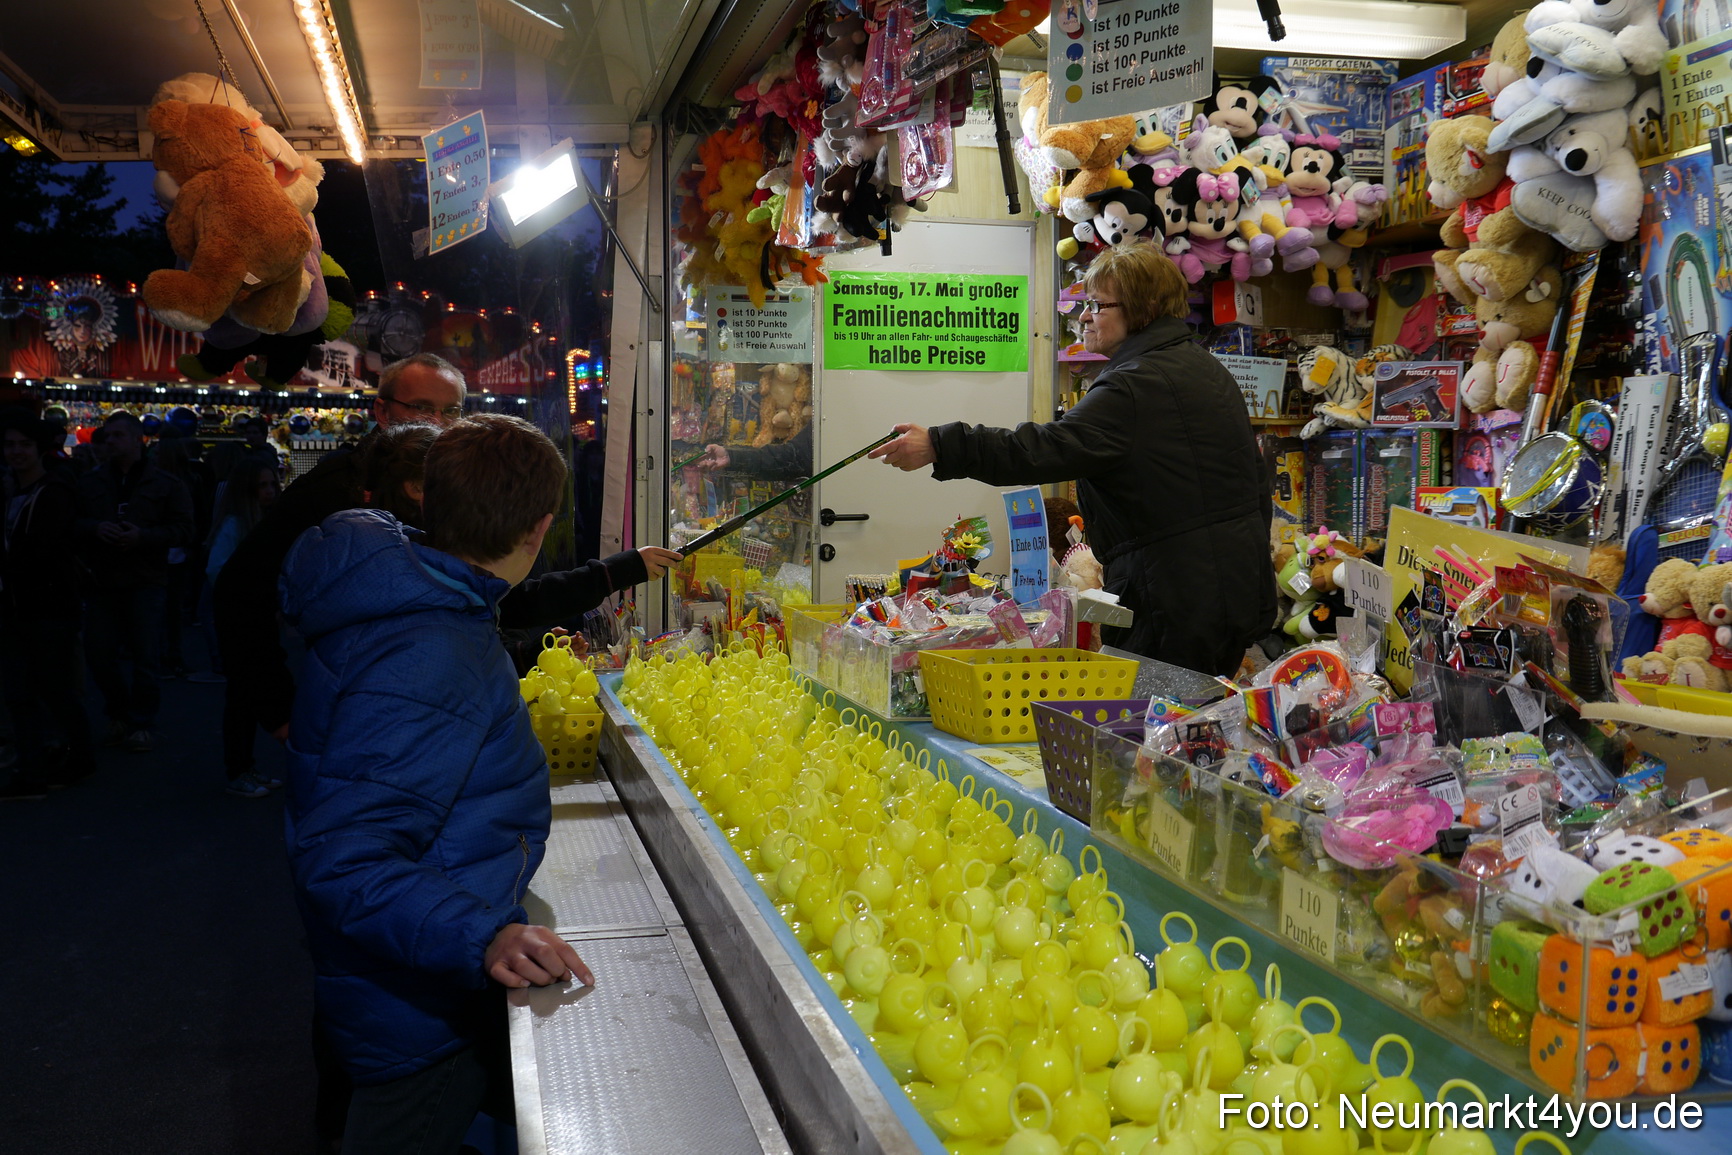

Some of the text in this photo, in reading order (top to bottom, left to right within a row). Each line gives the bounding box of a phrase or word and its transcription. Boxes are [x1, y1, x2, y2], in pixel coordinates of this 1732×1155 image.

[1094, 2, 1180, 32] ist 10 Punkte
[1093, 24, 1179, 53] ist 50 Punkte
[1092, 44, 1186, 74] ist 100 Punkte
[1292, 58, 1373, 68] AIRPORT CATENA
[1092, 57, 1204, 95] ist Freie Auswahl
[1672, 69, 1713, 90] 1 Ente
[1673, 84, 1724, 106] 7 Enten
[464, 148, 486, 166] 0,50
[433, 189, 442, 205] 7
[443, 183, 467, 200] Enten
[1538, 187, 1564, 206] KEEP
[432, 213, 446, 231] 12
[447, 208, 470, 223] Enten
[833, 280, 1019, 300] Samstag, 17. Mai großer
[732, 309, 787, 317] ist 10 Punkte
[732, 320, 787, 328] ist 50 Punkte
[833, 304, 1019, 334] Familienachmittag
[733, 330, 743, 338] ist
[763, 331, 792, 339] Punkte
[834, 332, 846, 341] bis
[849, 332, 858, 340] 19
[861, 332, 874, 341] Uhr
[889, 332, 910, 341] allen
[912, 333, 932, 342] Fahr-
[935, 333, 949, 342] und
[951, 334, 1018, 344] Schaugeschäften
[770, 342, 806, 350] Auswahl
[869, 345, 986, 365] halbe Preise
[1621, 386, 1631, 400] Air
[1617, 403, 1628, 431] Pellets
[1648, 405, 1660, 429] Fusil
[1421, 432, 1431, 466] SPORTS
[1661, 429, 1673, 456] Pellets
[1640, 440, 1654, 476] Pompe
[1656, 460, 1667, 473] Air
[1632, 490, 1644, 517] Billes
[1011, 536, 1047, 552] 1 Ente 0,50
[1668, 525, 1710, 543] Sports
[1014, 568, 1019, 587] 7
[1361, 570, 1380, 590] 110
[1351, 590, 1387, 618] Punkte
[1151, 834, 1181, 872] Punkte
[1299, 887, 1321, 917] 110
[1286, 915, 1328, 956] Punkte
